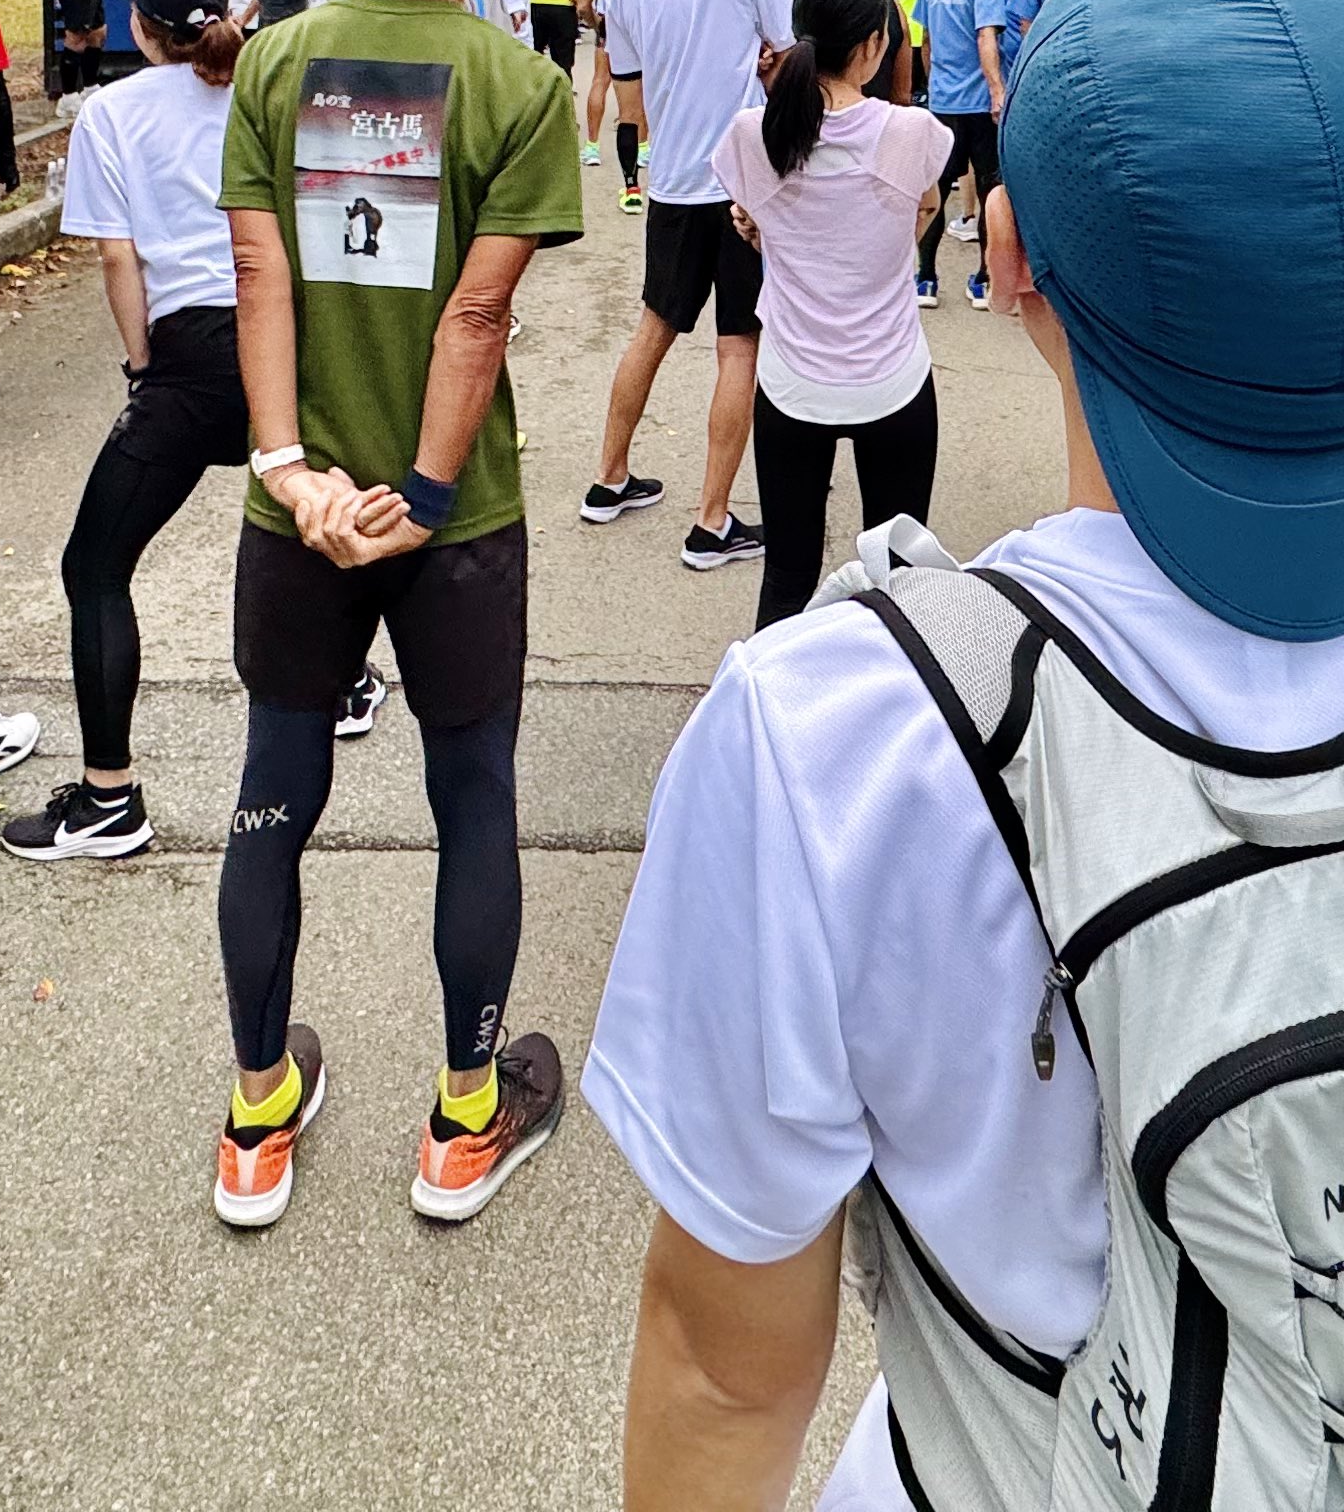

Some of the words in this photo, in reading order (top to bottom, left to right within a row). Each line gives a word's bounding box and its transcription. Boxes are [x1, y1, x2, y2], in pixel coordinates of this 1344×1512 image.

[351, 109, 424, 140] 宮古馬
[233, 804, 290, 834] CW-X
